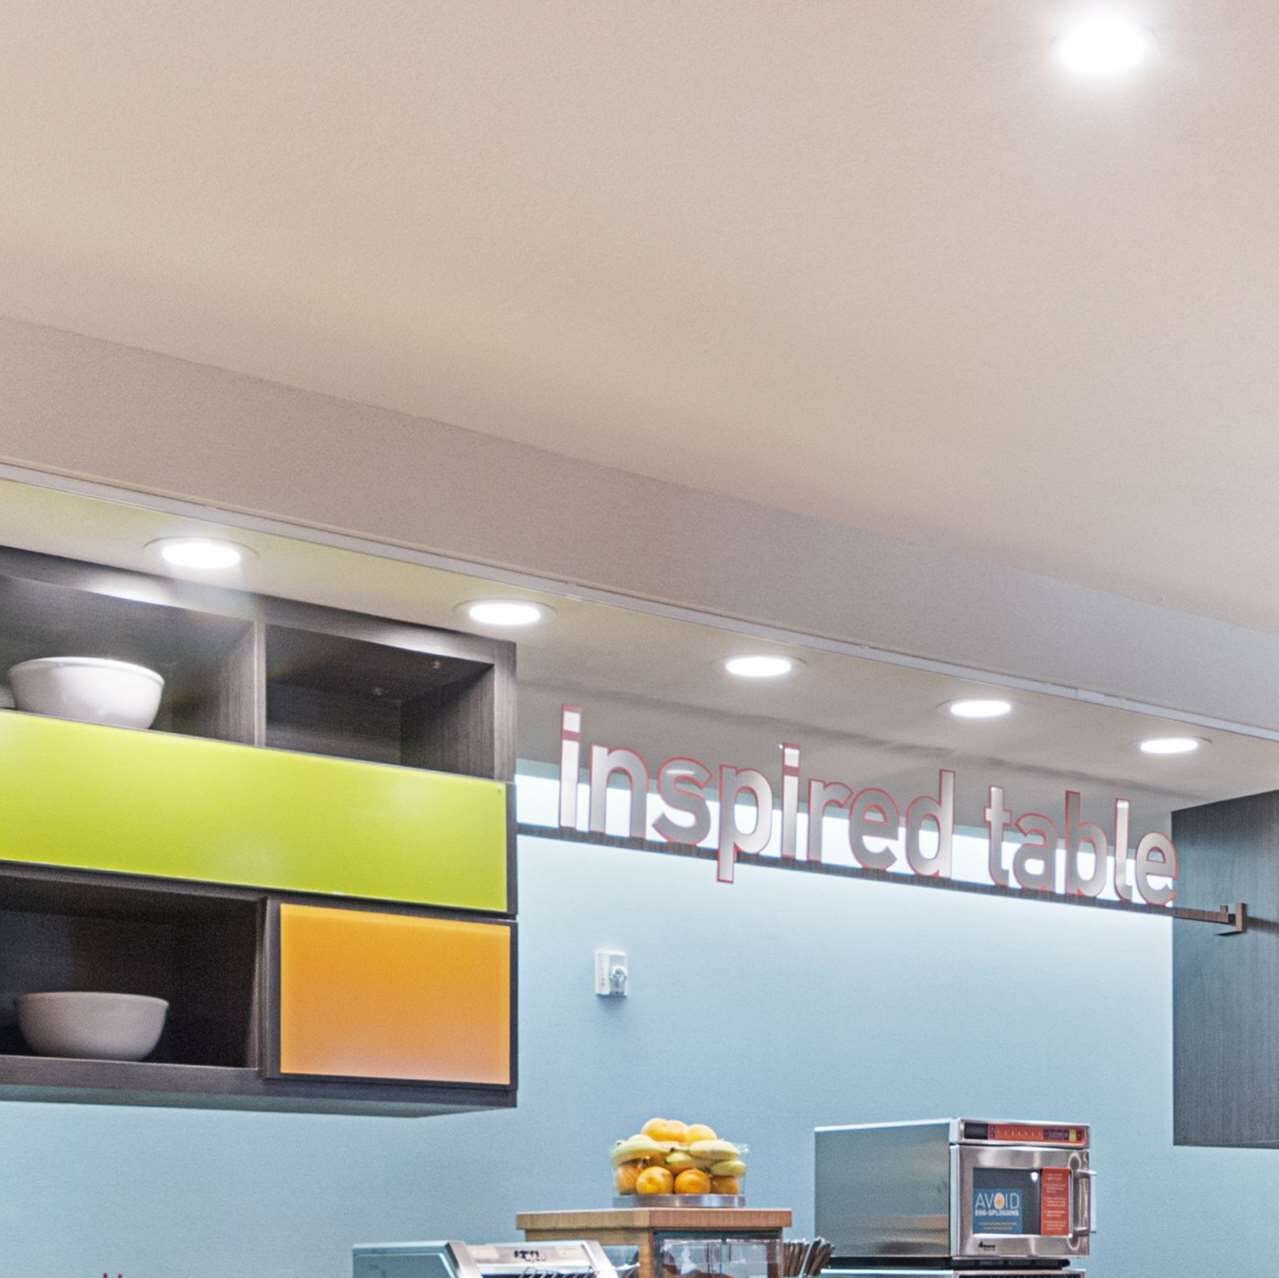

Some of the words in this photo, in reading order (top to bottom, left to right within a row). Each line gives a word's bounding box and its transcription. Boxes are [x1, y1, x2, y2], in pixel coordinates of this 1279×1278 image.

[560, 703, 956, 883] inspired
[985, 785, 1178, 906] table
[975, 1192, 1020, 1210] AVOID
